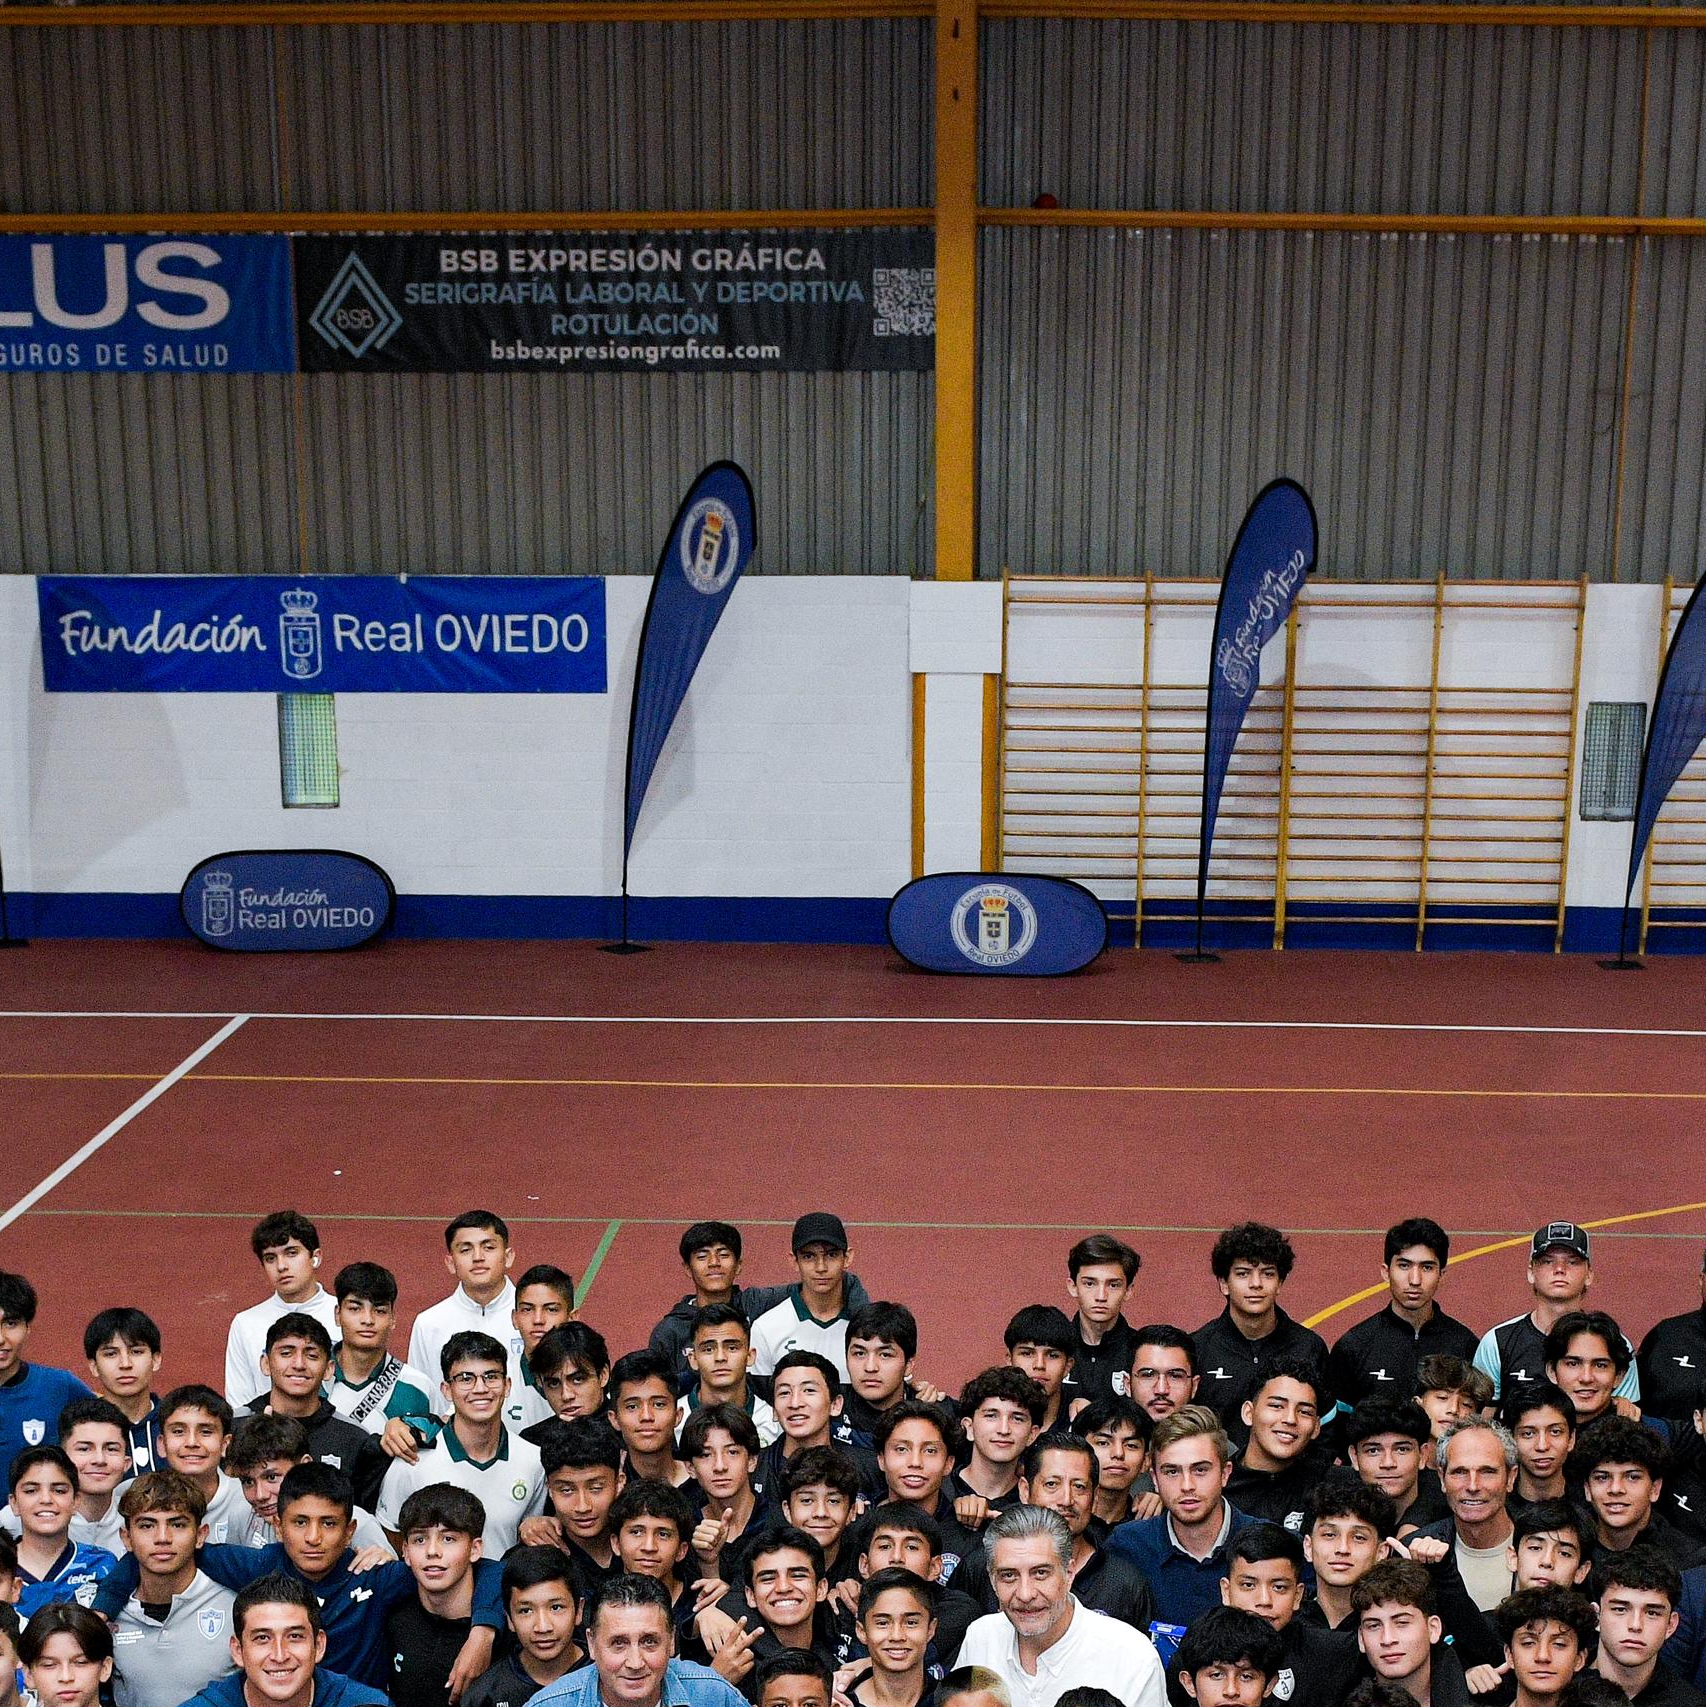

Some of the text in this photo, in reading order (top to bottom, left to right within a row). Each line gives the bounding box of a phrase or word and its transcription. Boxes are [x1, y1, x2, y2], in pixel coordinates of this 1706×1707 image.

[439, 243, 825, 273] BSB EXPRESIÓN GRÁFICA
[404, 277, 865, 304] SERIGRAFÍA LABORAL Y DEPORTIVA
[551, 307, 719, 337] ROTULACIÓN
[96, 344, 129, 366] DE
[144, 344, 229, 367] SALUD
[491, 338, 781, 366] bsbexpresiongrafica.com
[59, 610, 590, 654] Fundación Real OVIEDO
[239, 887, 329, 908] Fundación
[239, 907, 374, 929] Real OVIEDO
[986, 949, 1020, 963] OVIEDO
